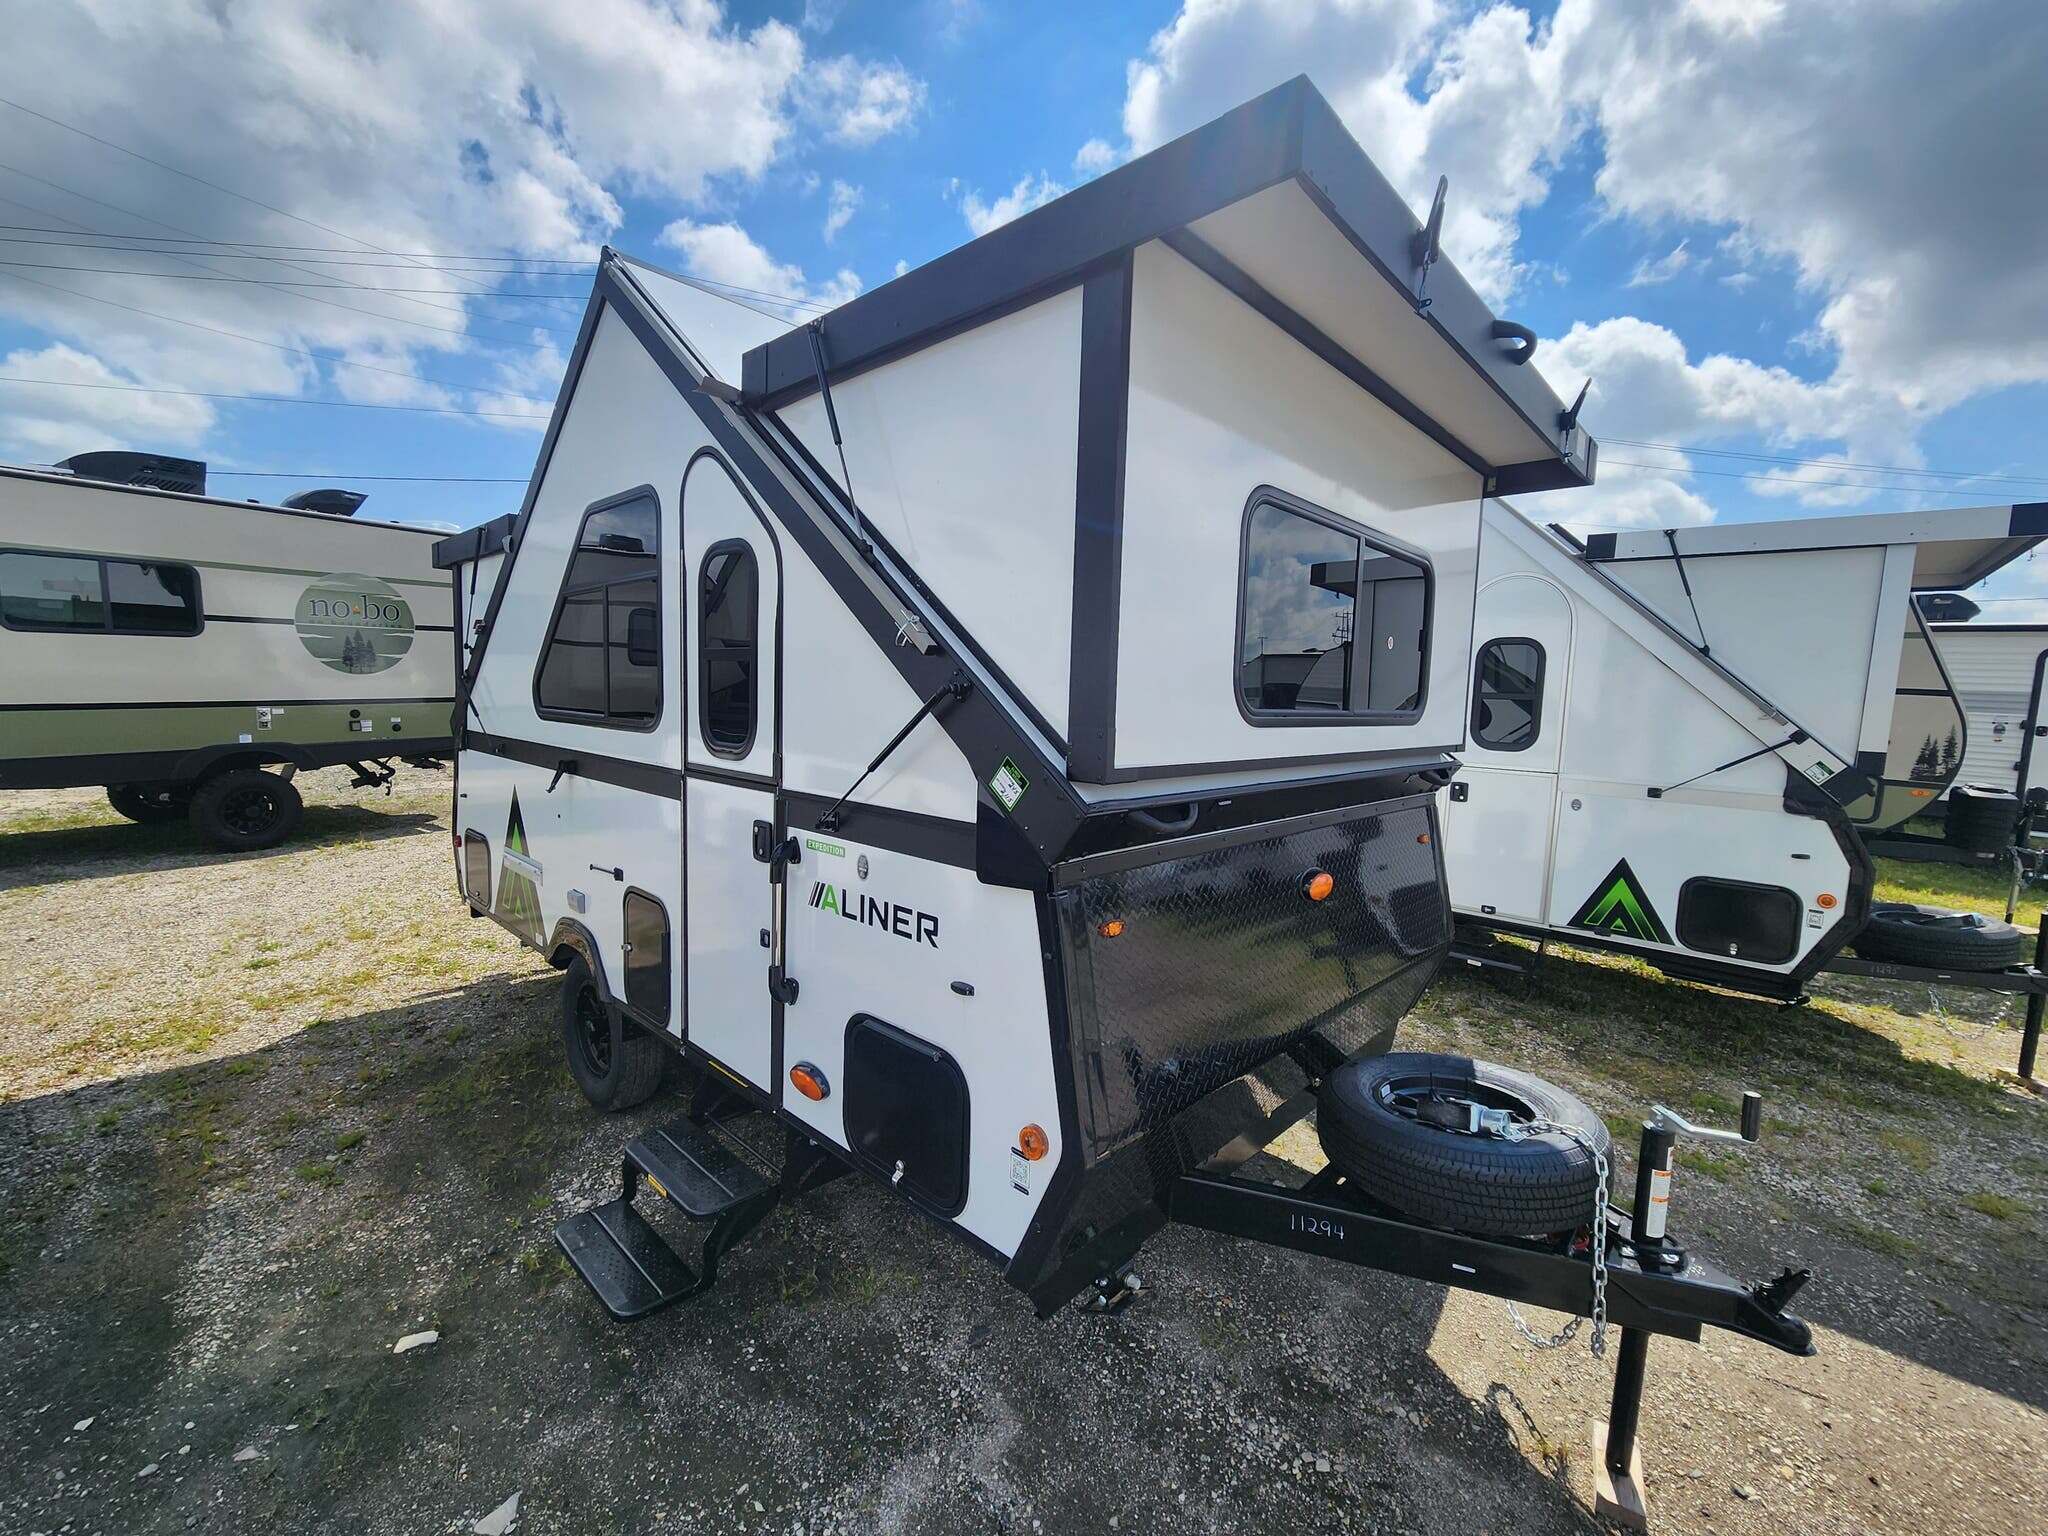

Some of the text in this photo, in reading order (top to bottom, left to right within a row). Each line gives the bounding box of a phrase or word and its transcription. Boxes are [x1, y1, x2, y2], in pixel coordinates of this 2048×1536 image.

[808, 840, 844, 857] EXPEDITION
[820, 883, 939, 949] ALINER
[1291, 1214, 1344, 1240] 11294
